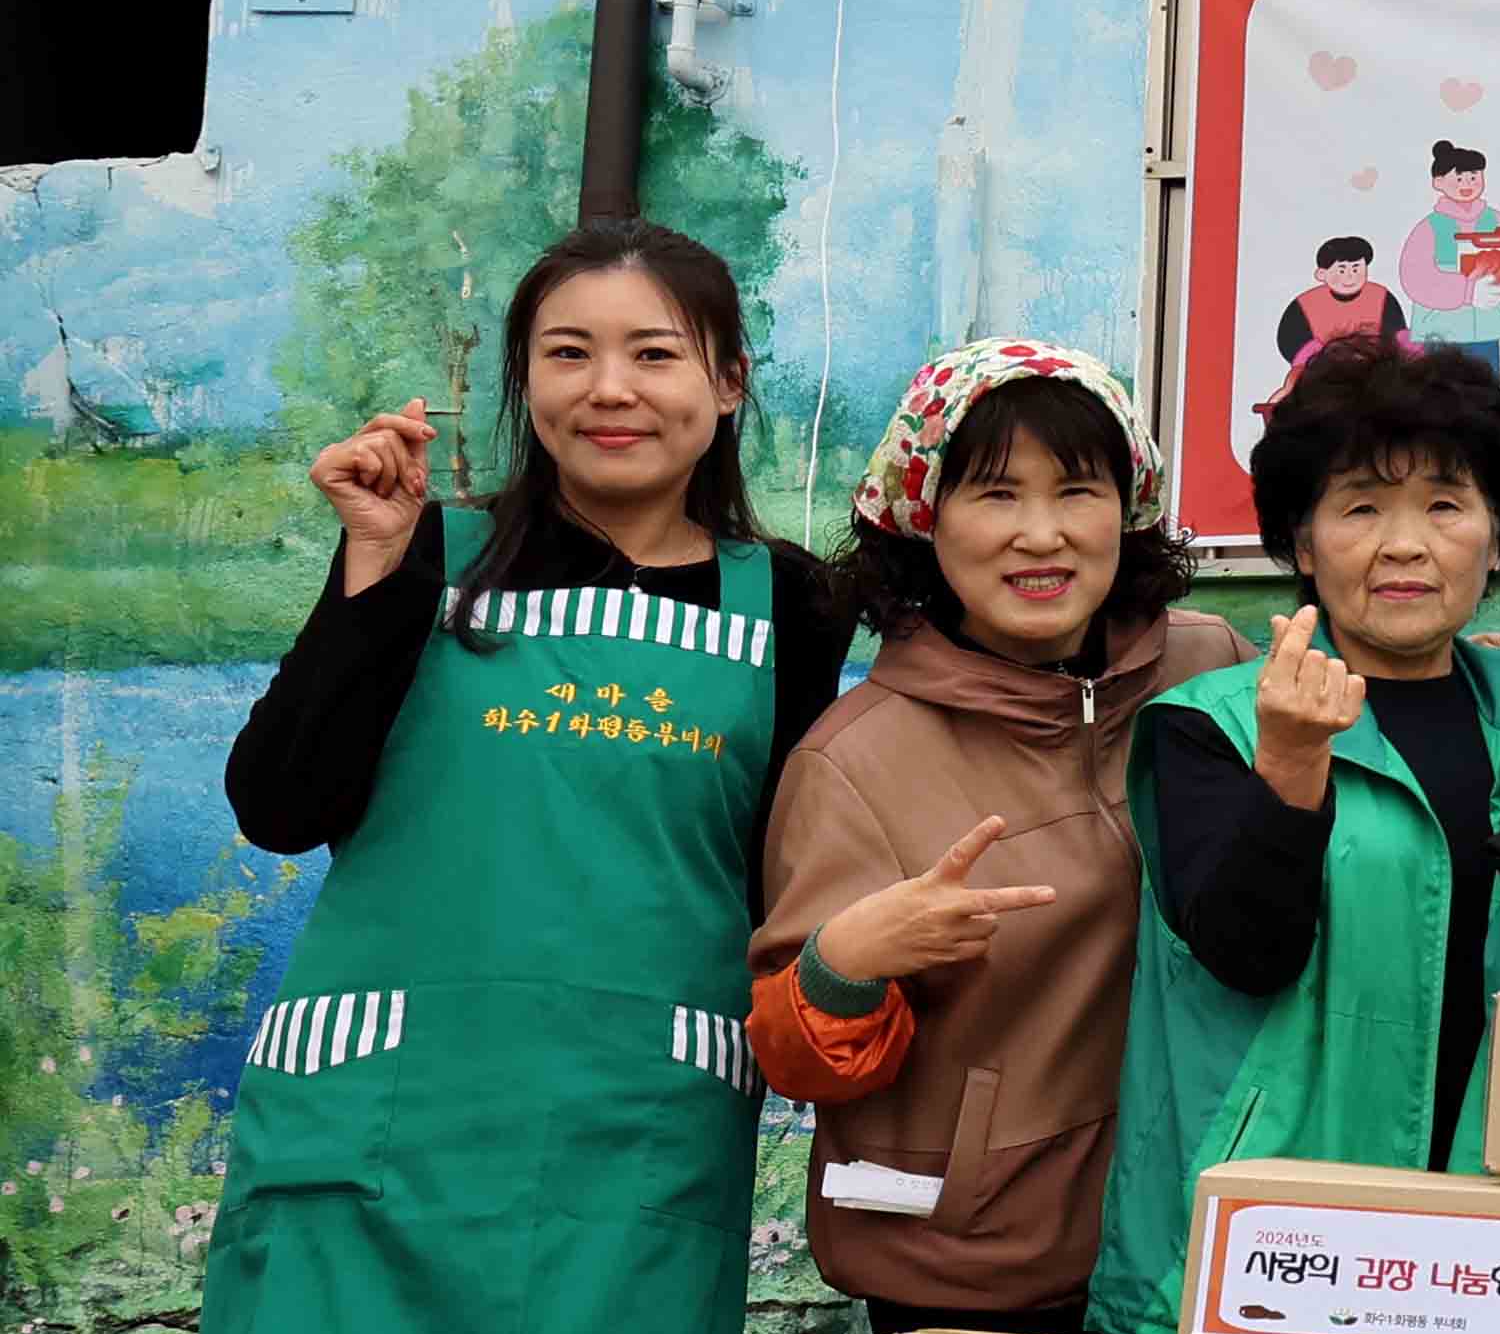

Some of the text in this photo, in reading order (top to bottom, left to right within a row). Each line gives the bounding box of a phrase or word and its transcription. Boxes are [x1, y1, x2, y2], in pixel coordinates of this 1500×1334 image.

[1254, 1229, 1327, 1249] 2024년도
[1243, 1249, 1340, 1286] 사랑의
[1354, 1257, 1417, 1292] 김장
